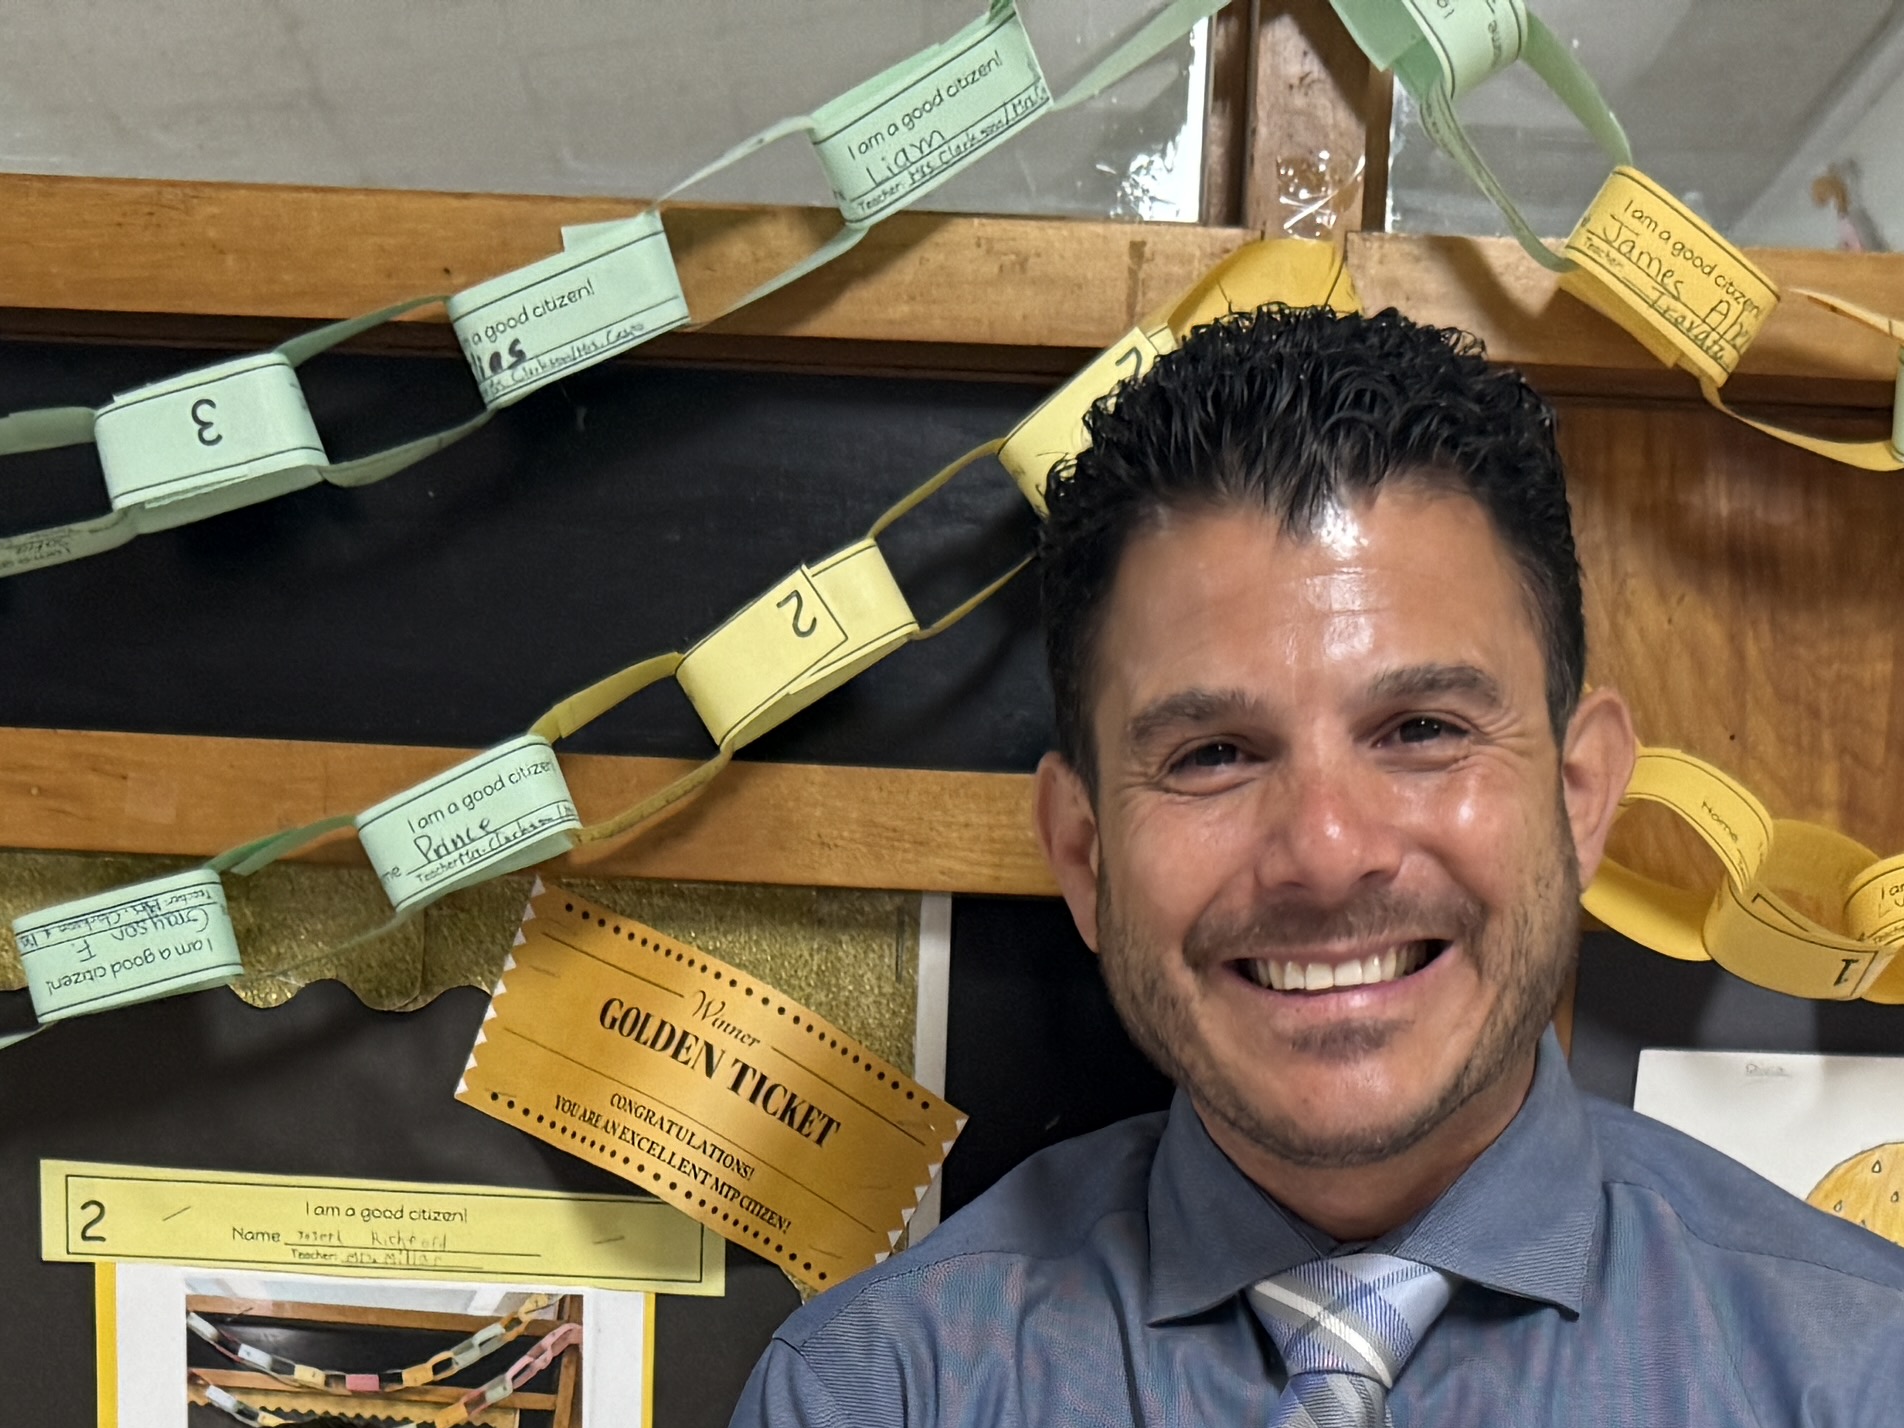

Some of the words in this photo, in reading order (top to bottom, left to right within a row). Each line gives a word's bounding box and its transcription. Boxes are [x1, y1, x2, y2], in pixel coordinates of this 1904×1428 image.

[848, 146, 855, 160] I
[858, 132, 885, 154] am
[887, 124, 899, 136] a
[902, 88, 942, 131] good
[946, 50, 1003, 97] citizen!
[866, 130, 945, 185] Liam
[1603, 214, 1685, 301] James
[190, 398, 224, 447] 3
[776, 589, 819, 640] 2
[408, 819, 415, 833] I
[419, 810, 446, 829] am
[448, 804, 460, 815] a
[463, 776, 505, 810] good
[414, 817, 490, 863] Prince
[1881, 887, 1885, 899] I
[111, 908, 209, 941] Grayson
[208, 938, 213, 951] I
[113, 950, 155, 977] good
[159, 951, 171, 961] a
[177, 942, 203, 956] am
[47, 966, 106, 997] citizen!
[693, 989, 761, 1049] Winner
[600, 997, 726, 1080] GOLDEN
[731, 1058, 841, 1149] TICKET
[610, 1093, 756, 1182] CONGRATULATIONS!
[555, 1094, 579, 1119] YOU
[619, 1125, 712, 1186] EXCELLENT
[712, 1175, 739, 1203] MTP
[738, 1189, 791, 1233] CITIZEN!
[79, 1200, 108, 1243] 2
[232, 1227, 280, 1244] Name
[306, 1202, 310, 1219] I
[313, 1206, 341, 1221] am
[346, 1208, 356, 1219] a
[361, 1206, 404, 1224] good
[409, 1204, 468, 1224] citizen!
